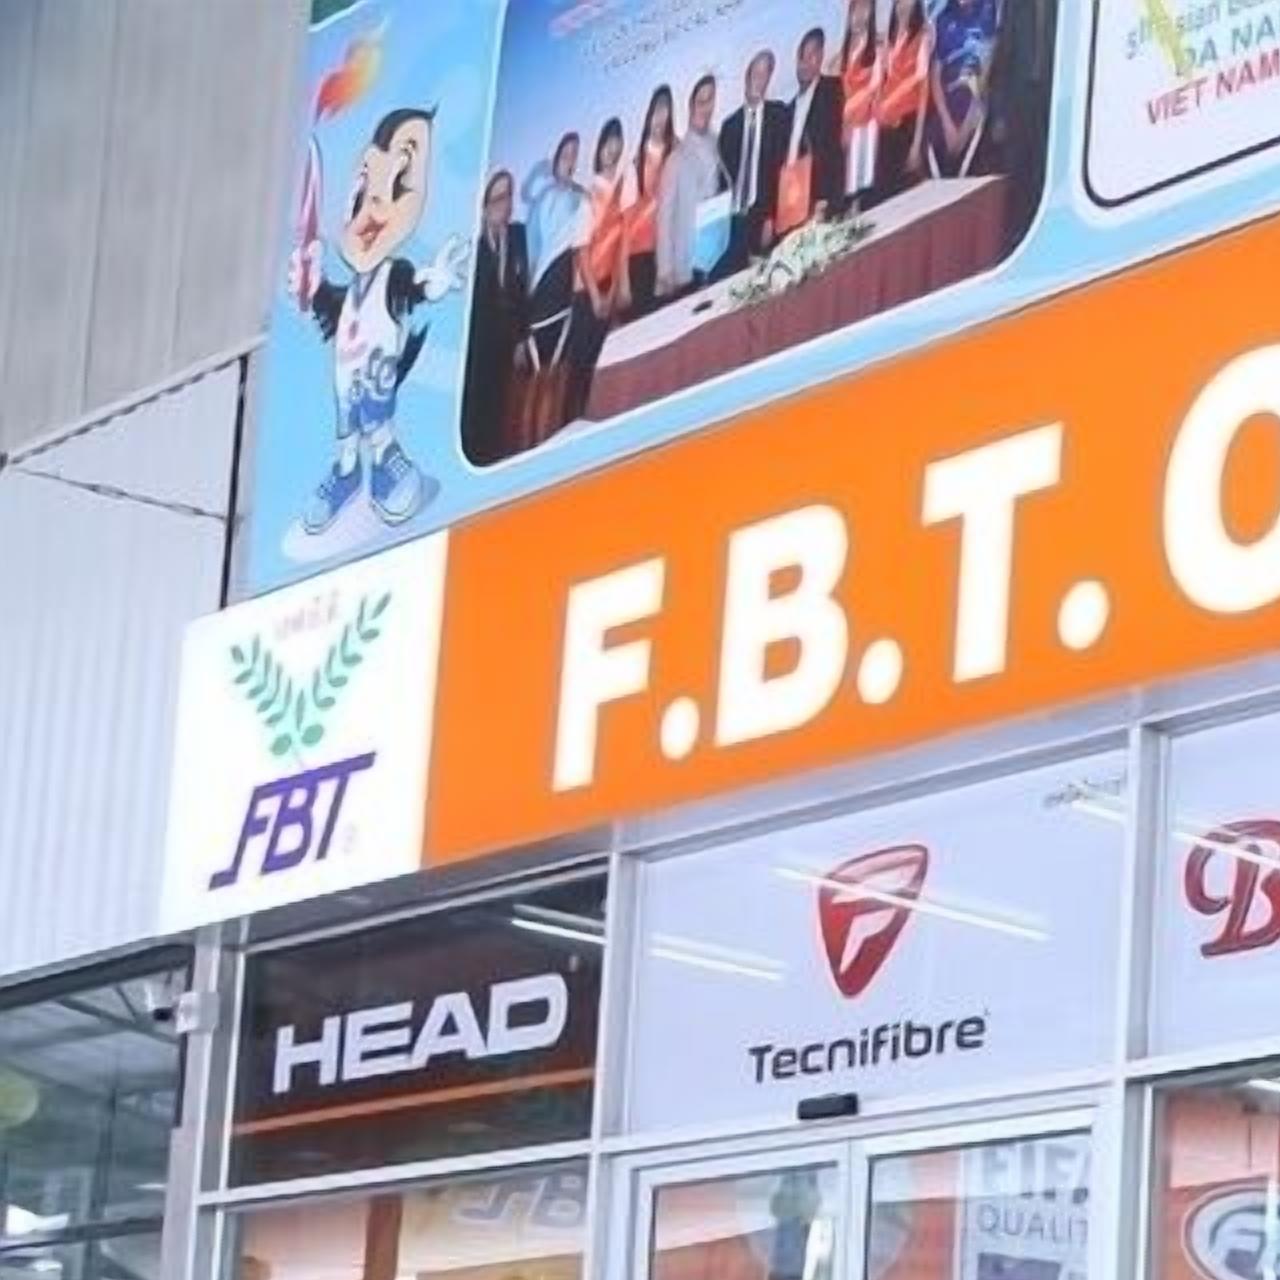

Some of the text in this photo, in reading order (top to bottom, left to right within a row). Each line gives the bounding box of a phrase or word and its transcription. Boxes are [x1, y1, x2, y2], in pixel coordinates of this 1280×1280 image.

[1148, 76, 1207, 124] VIET
[1215, 48, 1280, 98] NAM
[552, 420, 1110, 792] F.B.T.
[208, 750, 377, 891] FBT
[272, 972, 569, 1094] HEAD
[748, 1015, 987, 1084] Tecnifibre
